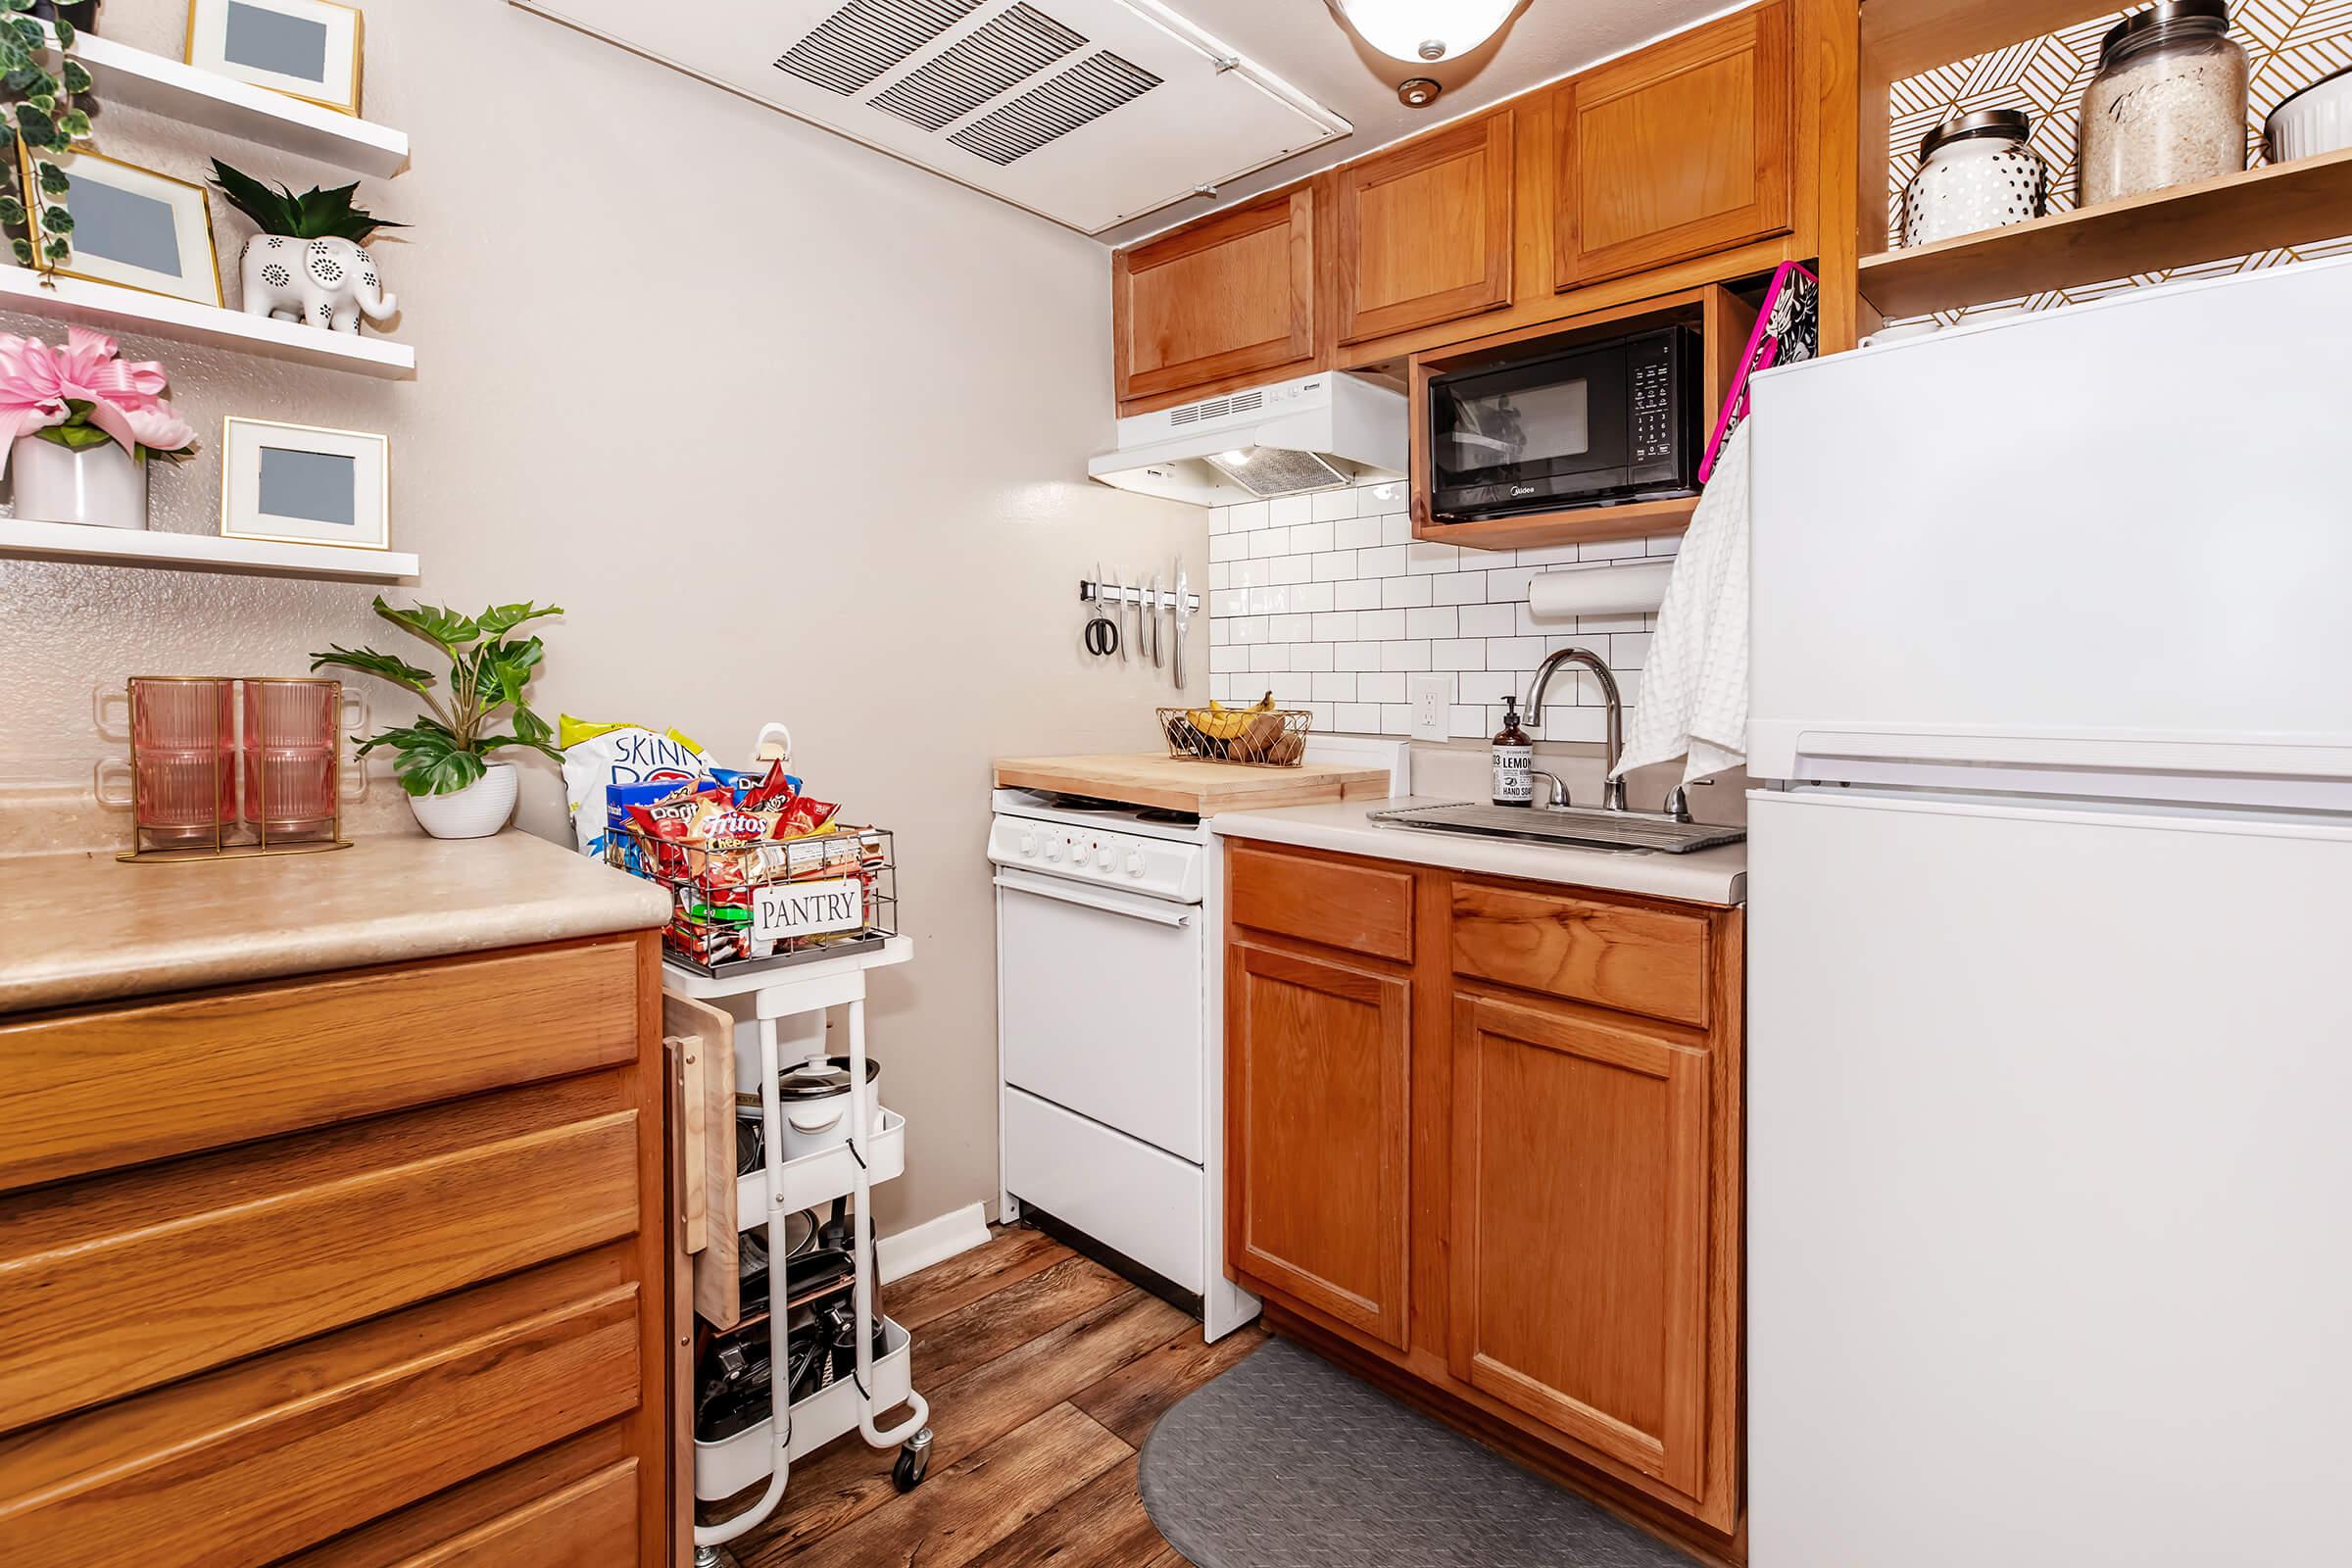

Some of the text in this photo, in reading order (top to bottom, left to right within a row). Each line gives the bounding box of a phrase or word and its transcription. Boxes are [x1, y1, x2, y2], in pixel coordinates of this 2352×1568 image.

[1503, 787, 1520, 796] HAND
[704, 812, 767, 838] Fritos
[761, 892, 856, 930] PANTRY
